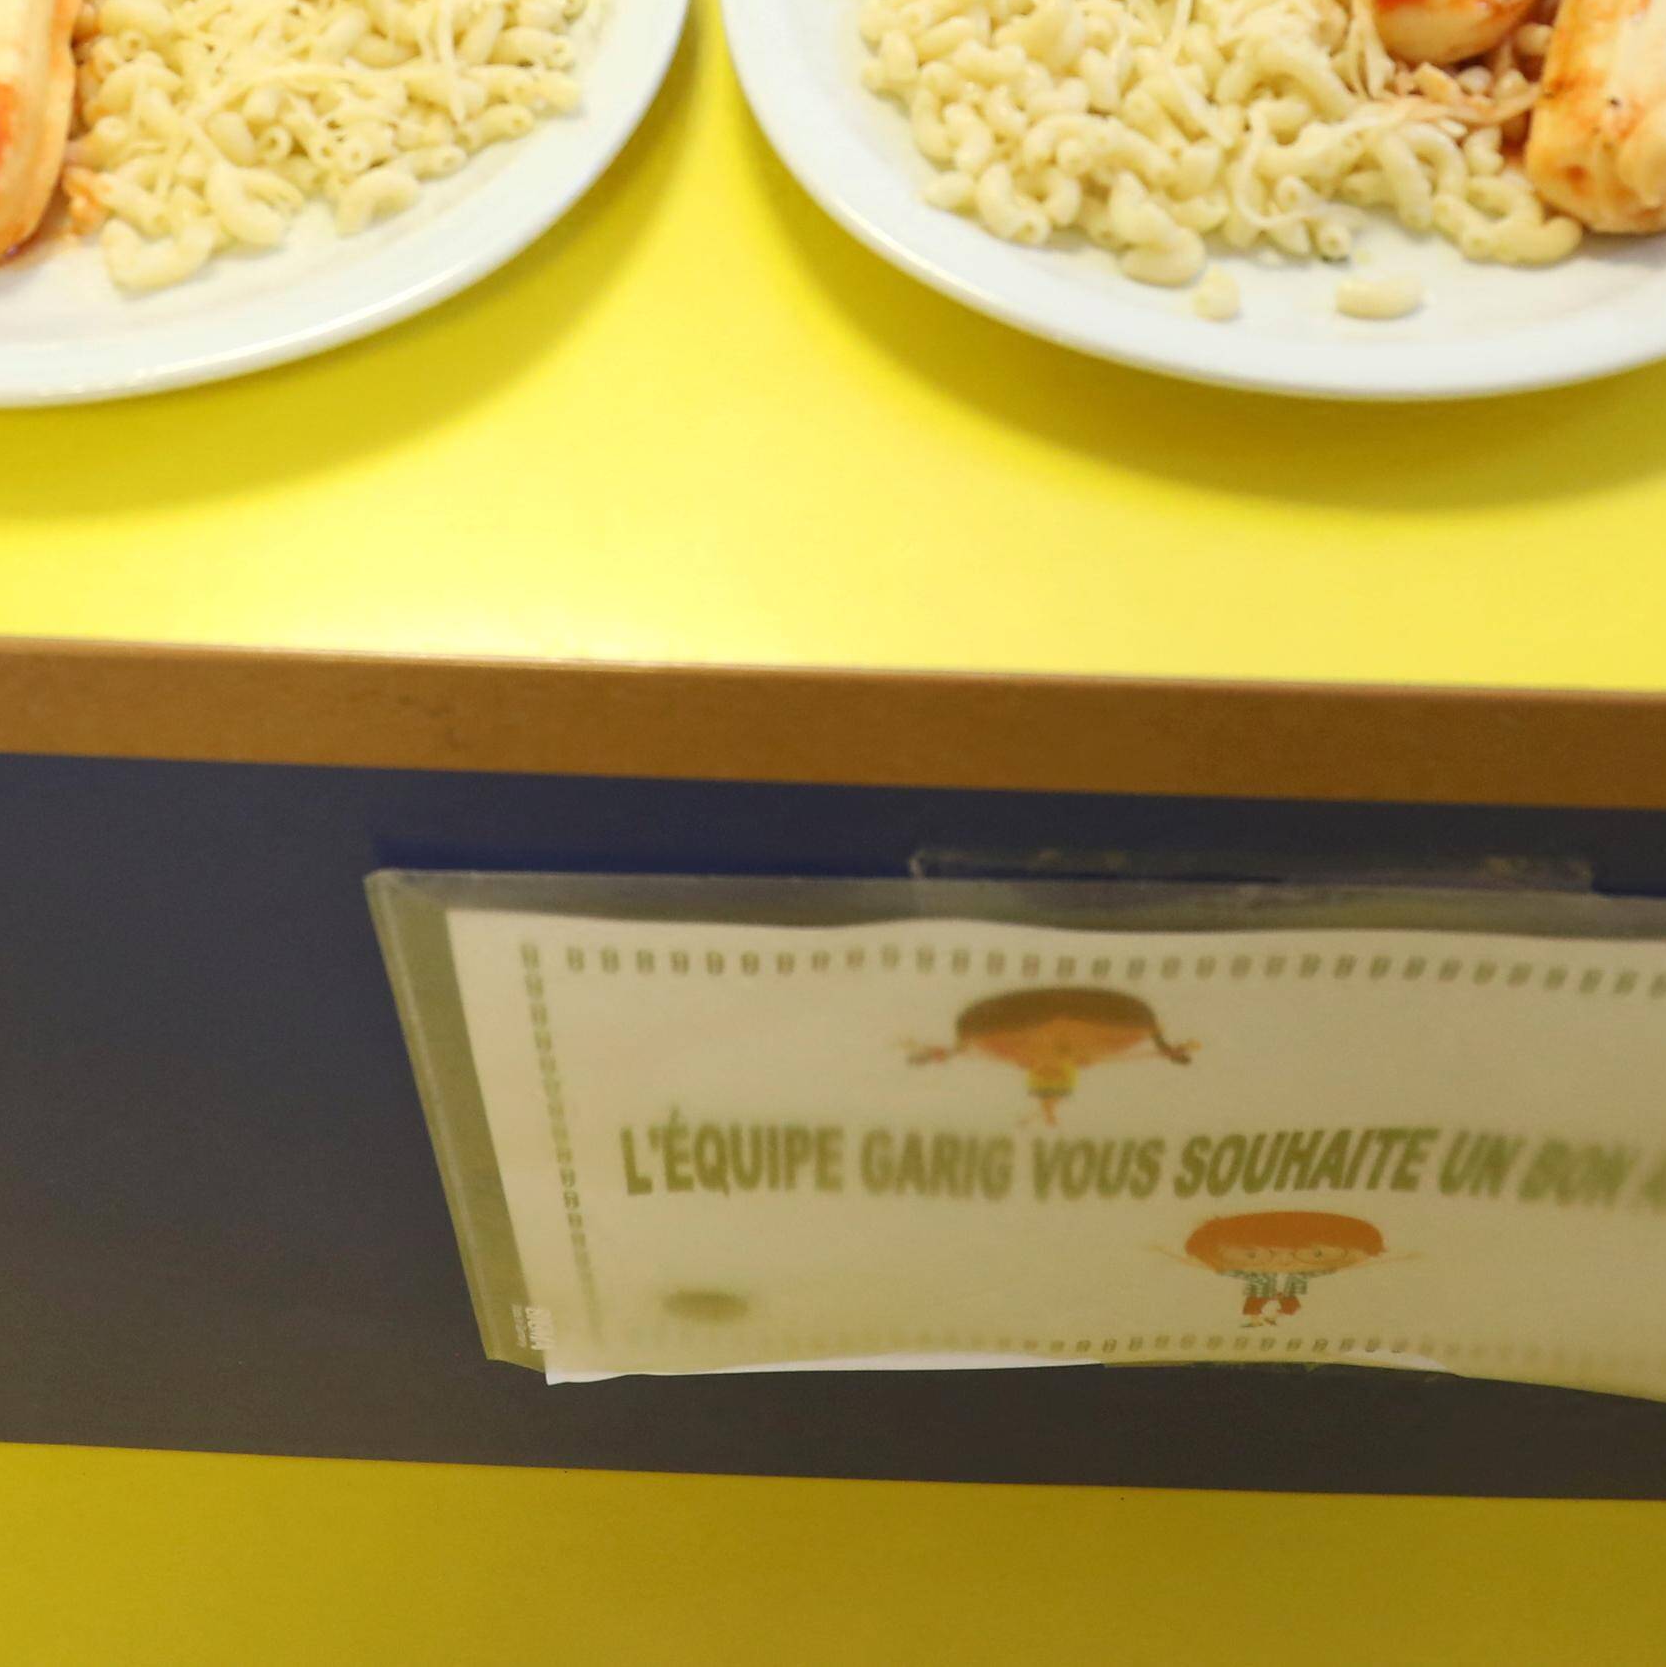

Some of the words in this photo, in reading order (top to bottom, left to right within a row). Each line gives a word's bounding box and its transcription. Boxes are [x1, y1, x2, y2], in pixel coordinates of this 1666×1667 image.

[620, 1107, 844, 1197] L'ÉQUIPE
[858, 1124, 1016, 1200] GARIG
[1033, 1133, 1165, 1200] VOUS
[1172, 1127, 1439, 1199] SOUHAITE
[1437, 1131, 1527, 1197] UN
